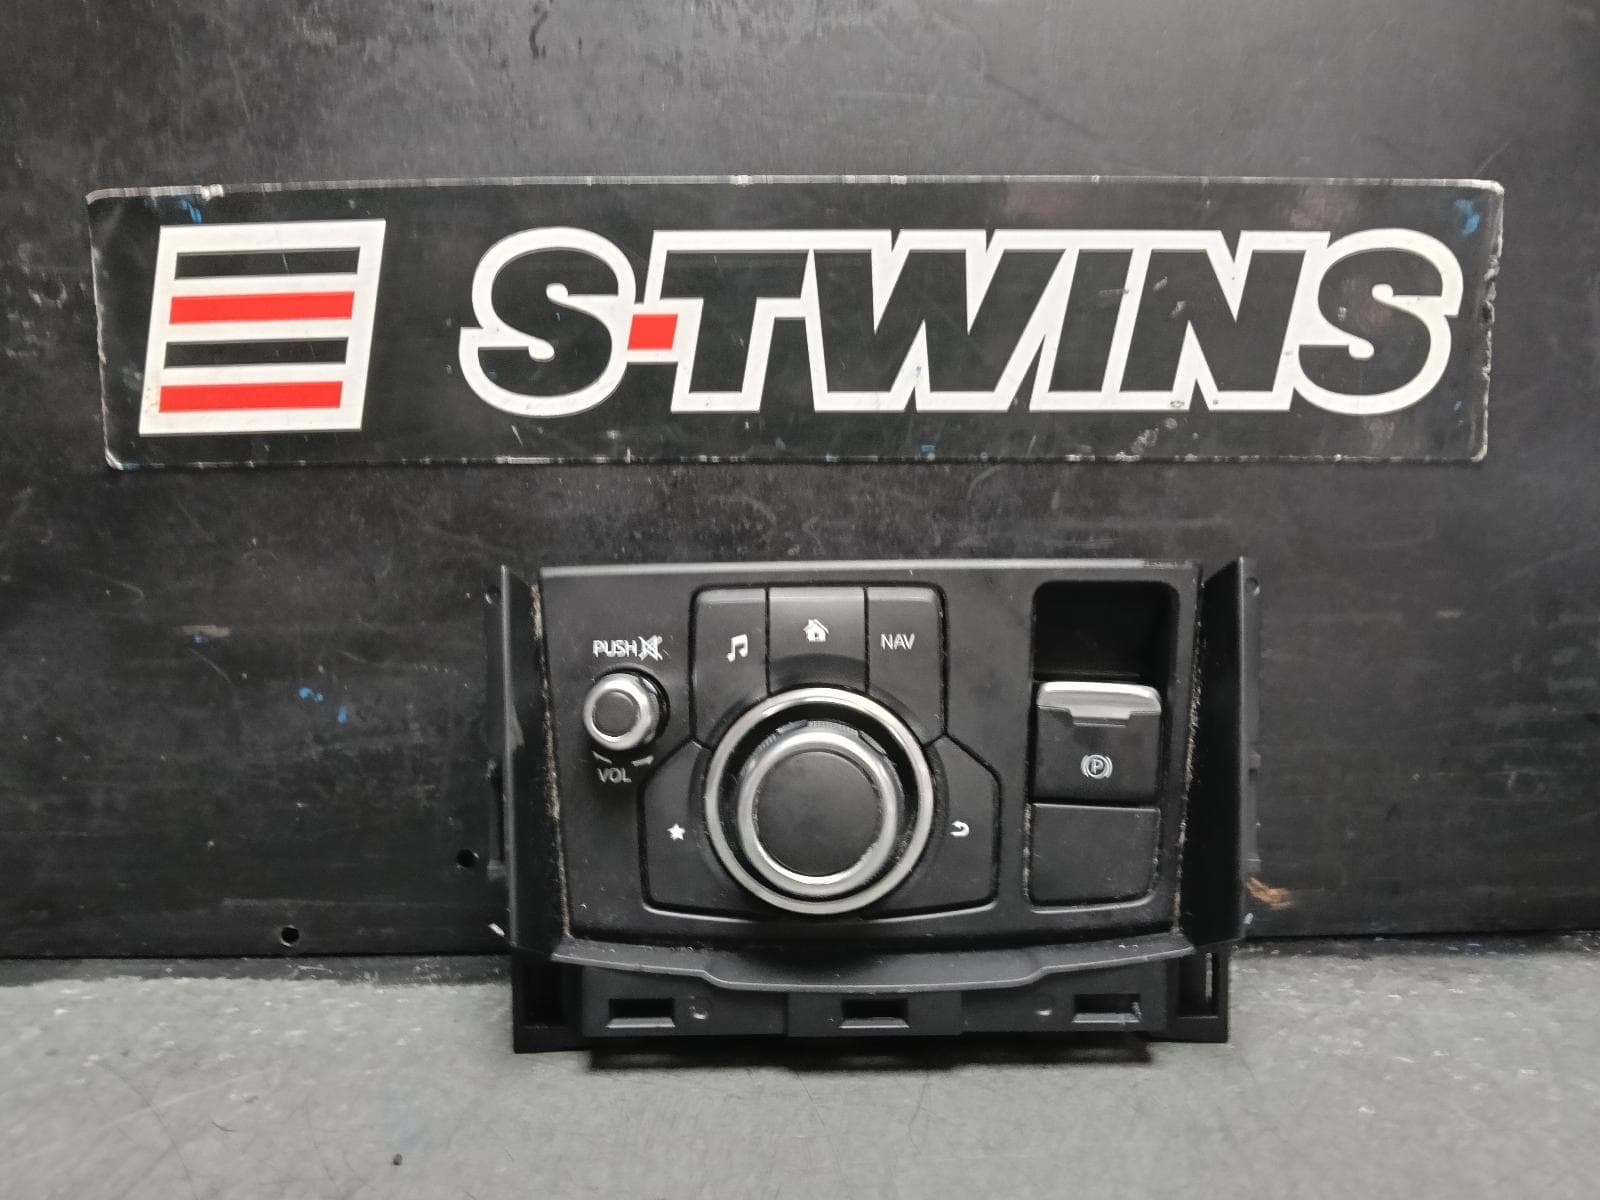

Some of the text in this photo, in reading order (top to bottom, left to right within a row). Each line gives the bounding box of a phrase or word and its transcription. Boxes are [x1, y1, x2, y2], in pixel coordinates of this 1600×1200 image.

[459, 227, 1464, 418] S-TWINS
[592, 639, 638, 657] PUSH
[880, 632, 915, 650] NAV
[597, 767, 632, 783] VOL
